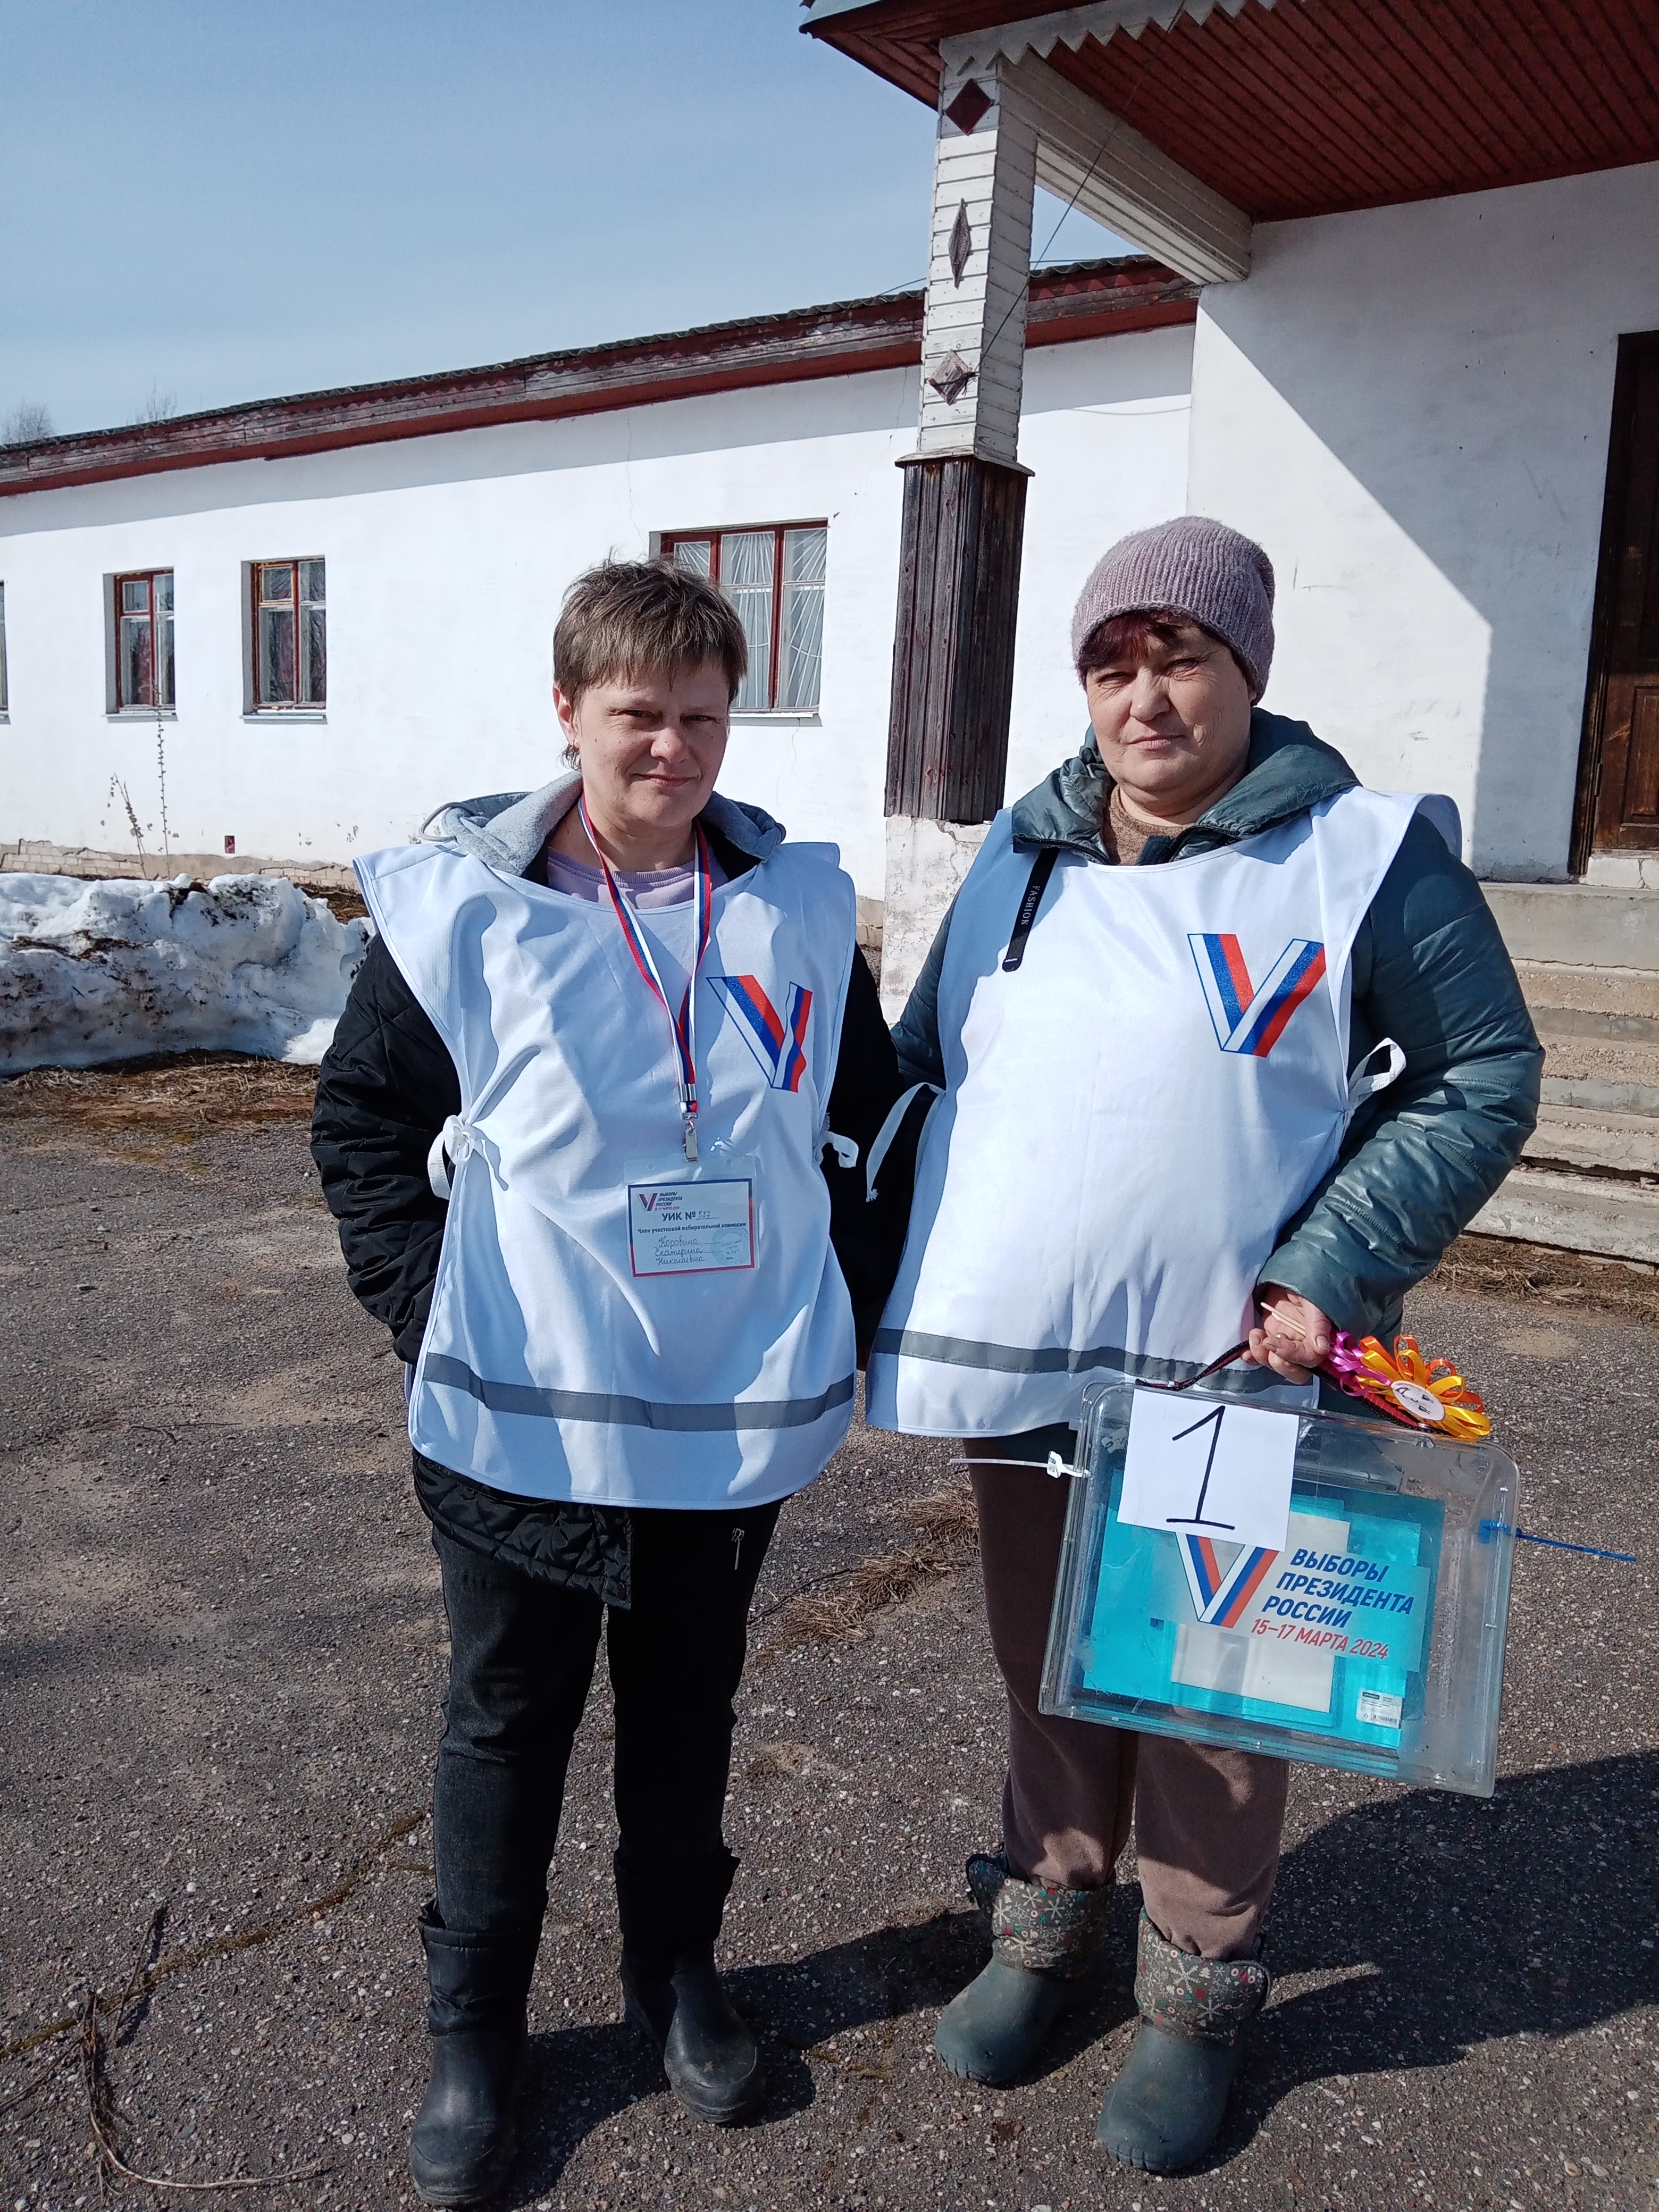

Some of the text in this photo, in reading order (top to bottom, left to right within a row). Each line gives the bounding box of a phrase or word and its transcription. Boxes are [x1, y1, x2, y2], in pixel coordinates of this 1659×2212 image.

[1020, 885, 1041, 925] FASHION
[661, 1212, 682, 1221] УИК
[685, 1211, 696, 1220] №
[1166, 1405, 1235, 1530] 1
[1290, 1548, 1389, 1582] ВЫБОРЫ
[1276, 1572, 1414, 1614] ПРЕЗИДЕНТА
[1261, 1595, 1352, 1628] РОССИИ
[1294, 1627, 1349, 1652] МАРТА
[1349, 1638, 1389, 1659] 2024
